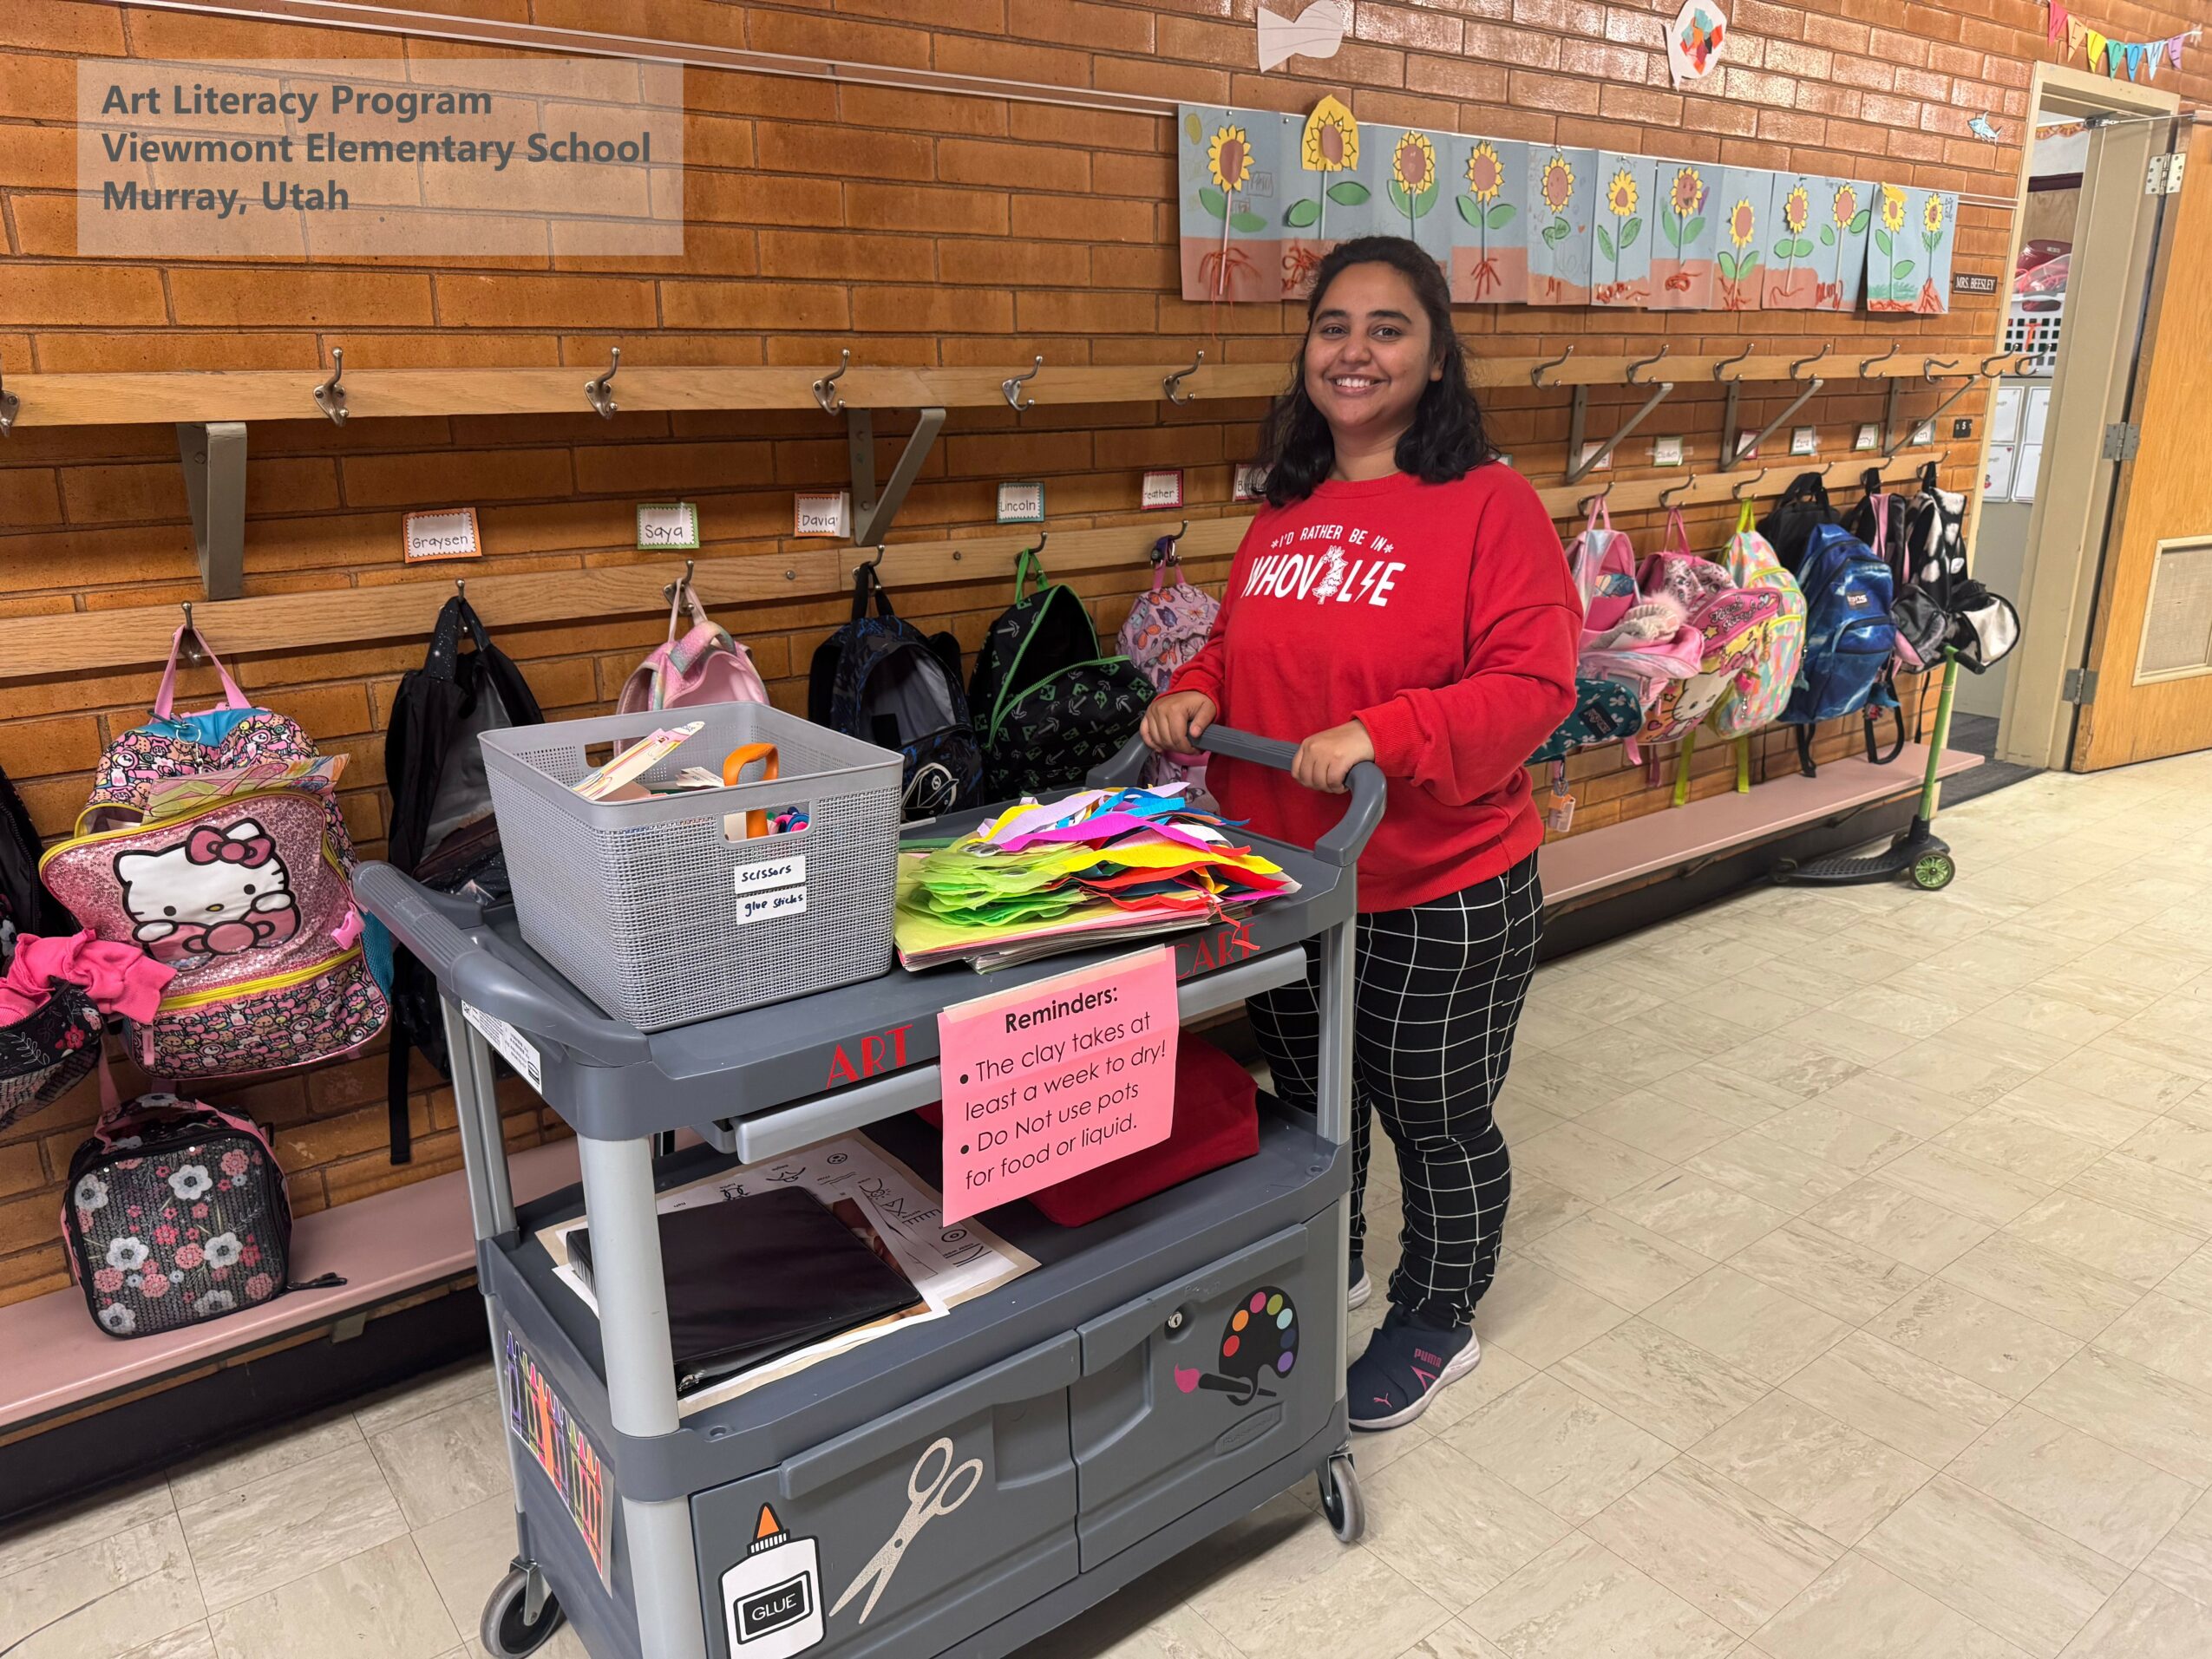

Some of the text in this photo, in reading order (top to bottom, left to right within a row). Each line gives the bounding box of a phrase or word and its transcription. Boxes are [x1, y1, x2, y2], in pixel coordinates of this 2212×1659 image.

[2051, 2, 2182, 71] WELCOME
[1970, 278, 1995, 291] BEESLEY
[1000, 499, 1036, 512] Lincoln
[412, 534, 468, 549] Graysen
[645, 523, 684, 539] Saya
[1299, 525, 1344, 541] RATHER
[1349, 528, 1368, 545] BE
[744, 894, 803, 918] glue sticks
[1005, 987, 1118, 1034] Reminders:
[826, 1023, 913, 1090] ART
[975, 1011, 1151, 1082] The clay takes at
[965, 1039, 1166, 1121] least a week to dry!
[978, 1082, 1139, 1152] Do Not use pots
[965, 1114, 1138, 1190] for food or liquid.
[1414, 1348, 1443, 1368] PUMA
[751, 1592, 797, 1621] GLUE
